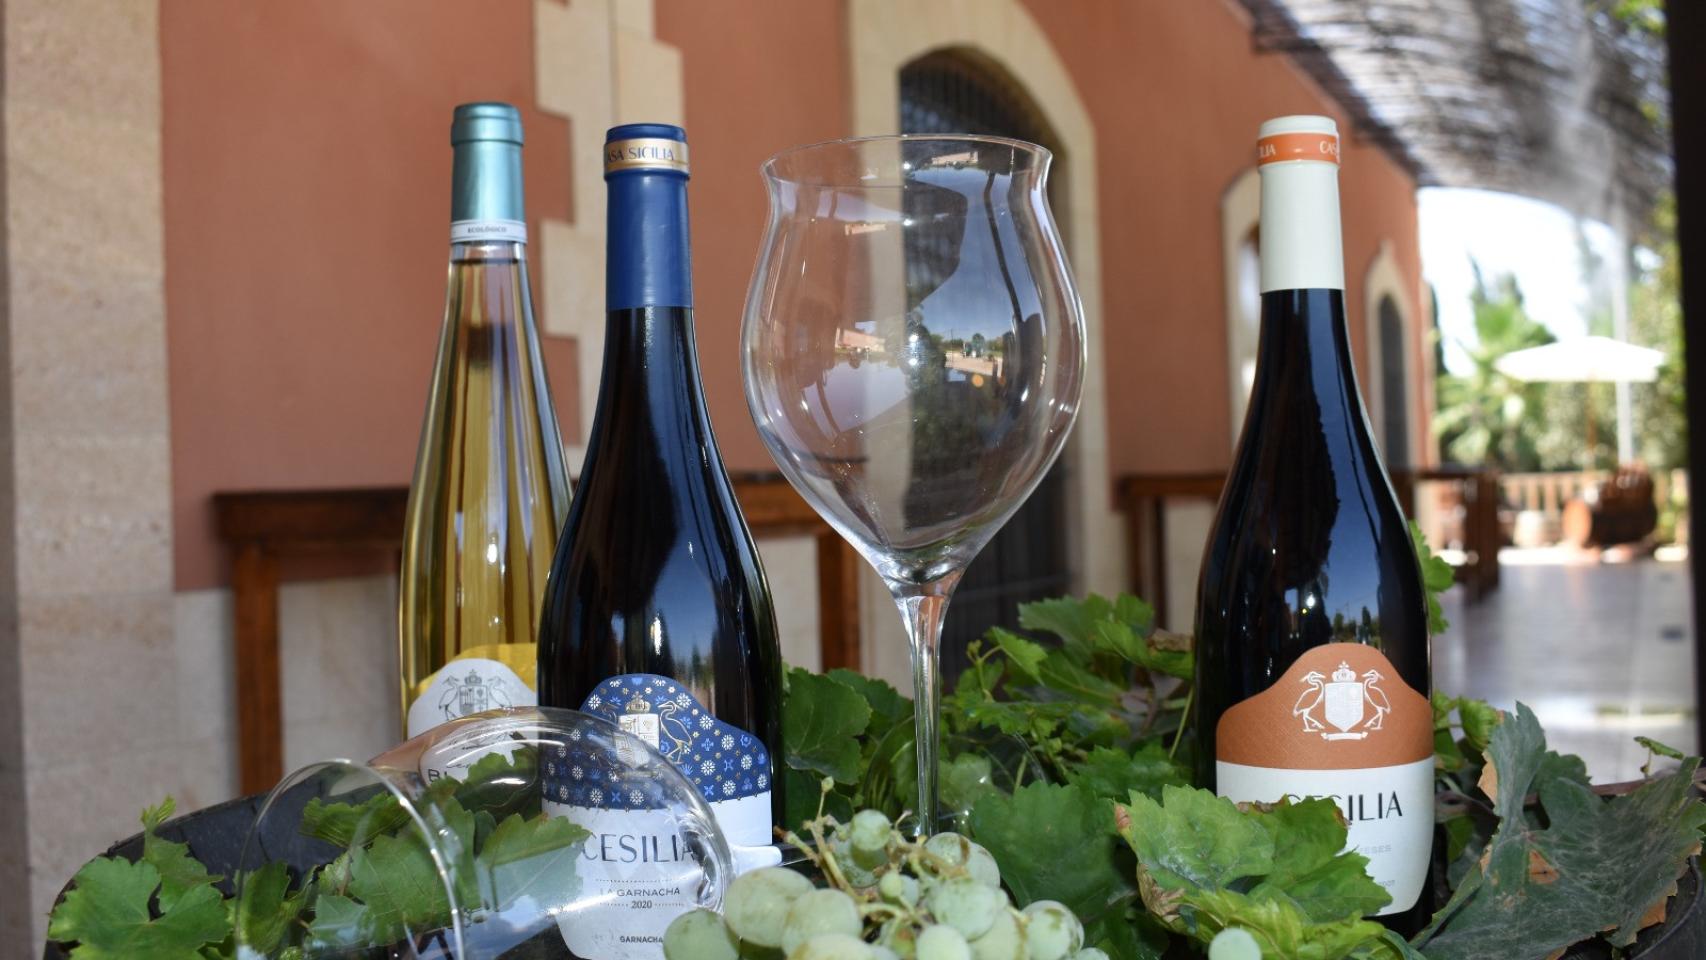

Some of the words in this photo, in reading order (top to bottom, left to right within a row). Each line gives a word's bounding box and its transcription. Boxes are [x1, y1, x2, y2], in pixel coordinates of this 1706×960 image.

[628, 146, 674, 161] SICILIA
[1287, 791, 1403, 825] ILIA
[616, 887, 681, 897] GARNACHA
[631, 900, 653, 909] 2020
